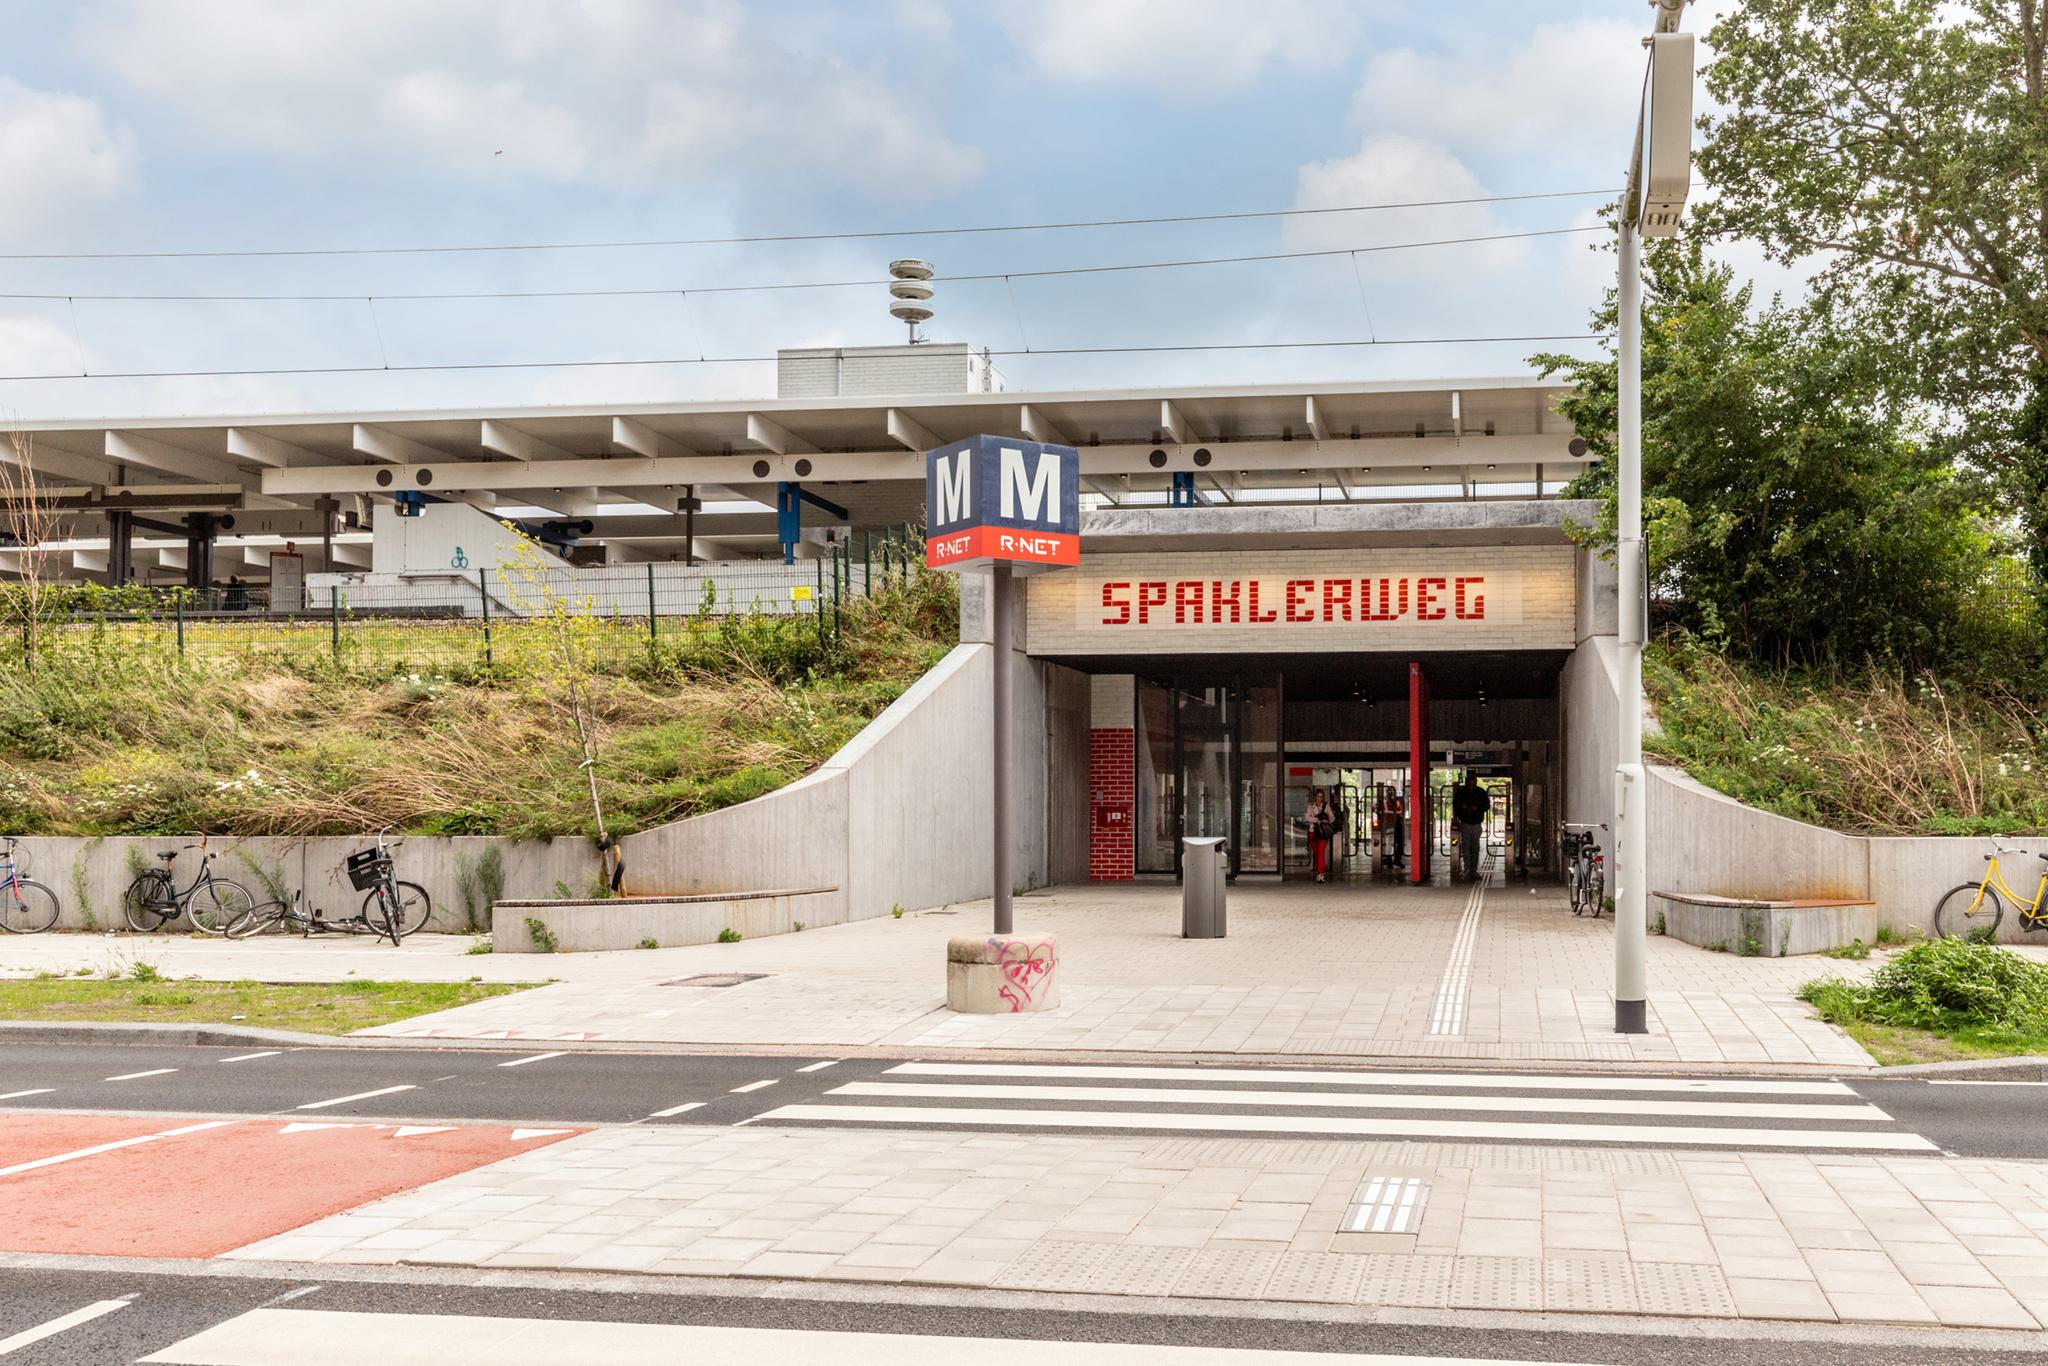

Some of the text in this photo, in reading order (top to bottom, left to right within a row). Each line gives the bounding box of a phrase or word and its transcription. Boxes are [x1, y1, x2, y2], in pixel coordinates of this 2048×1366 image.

[936, 448, 971, 527] M
[1000, 447, 1061, 524] M
[1102, 577, 1485, 625] SPAKLERWEG
